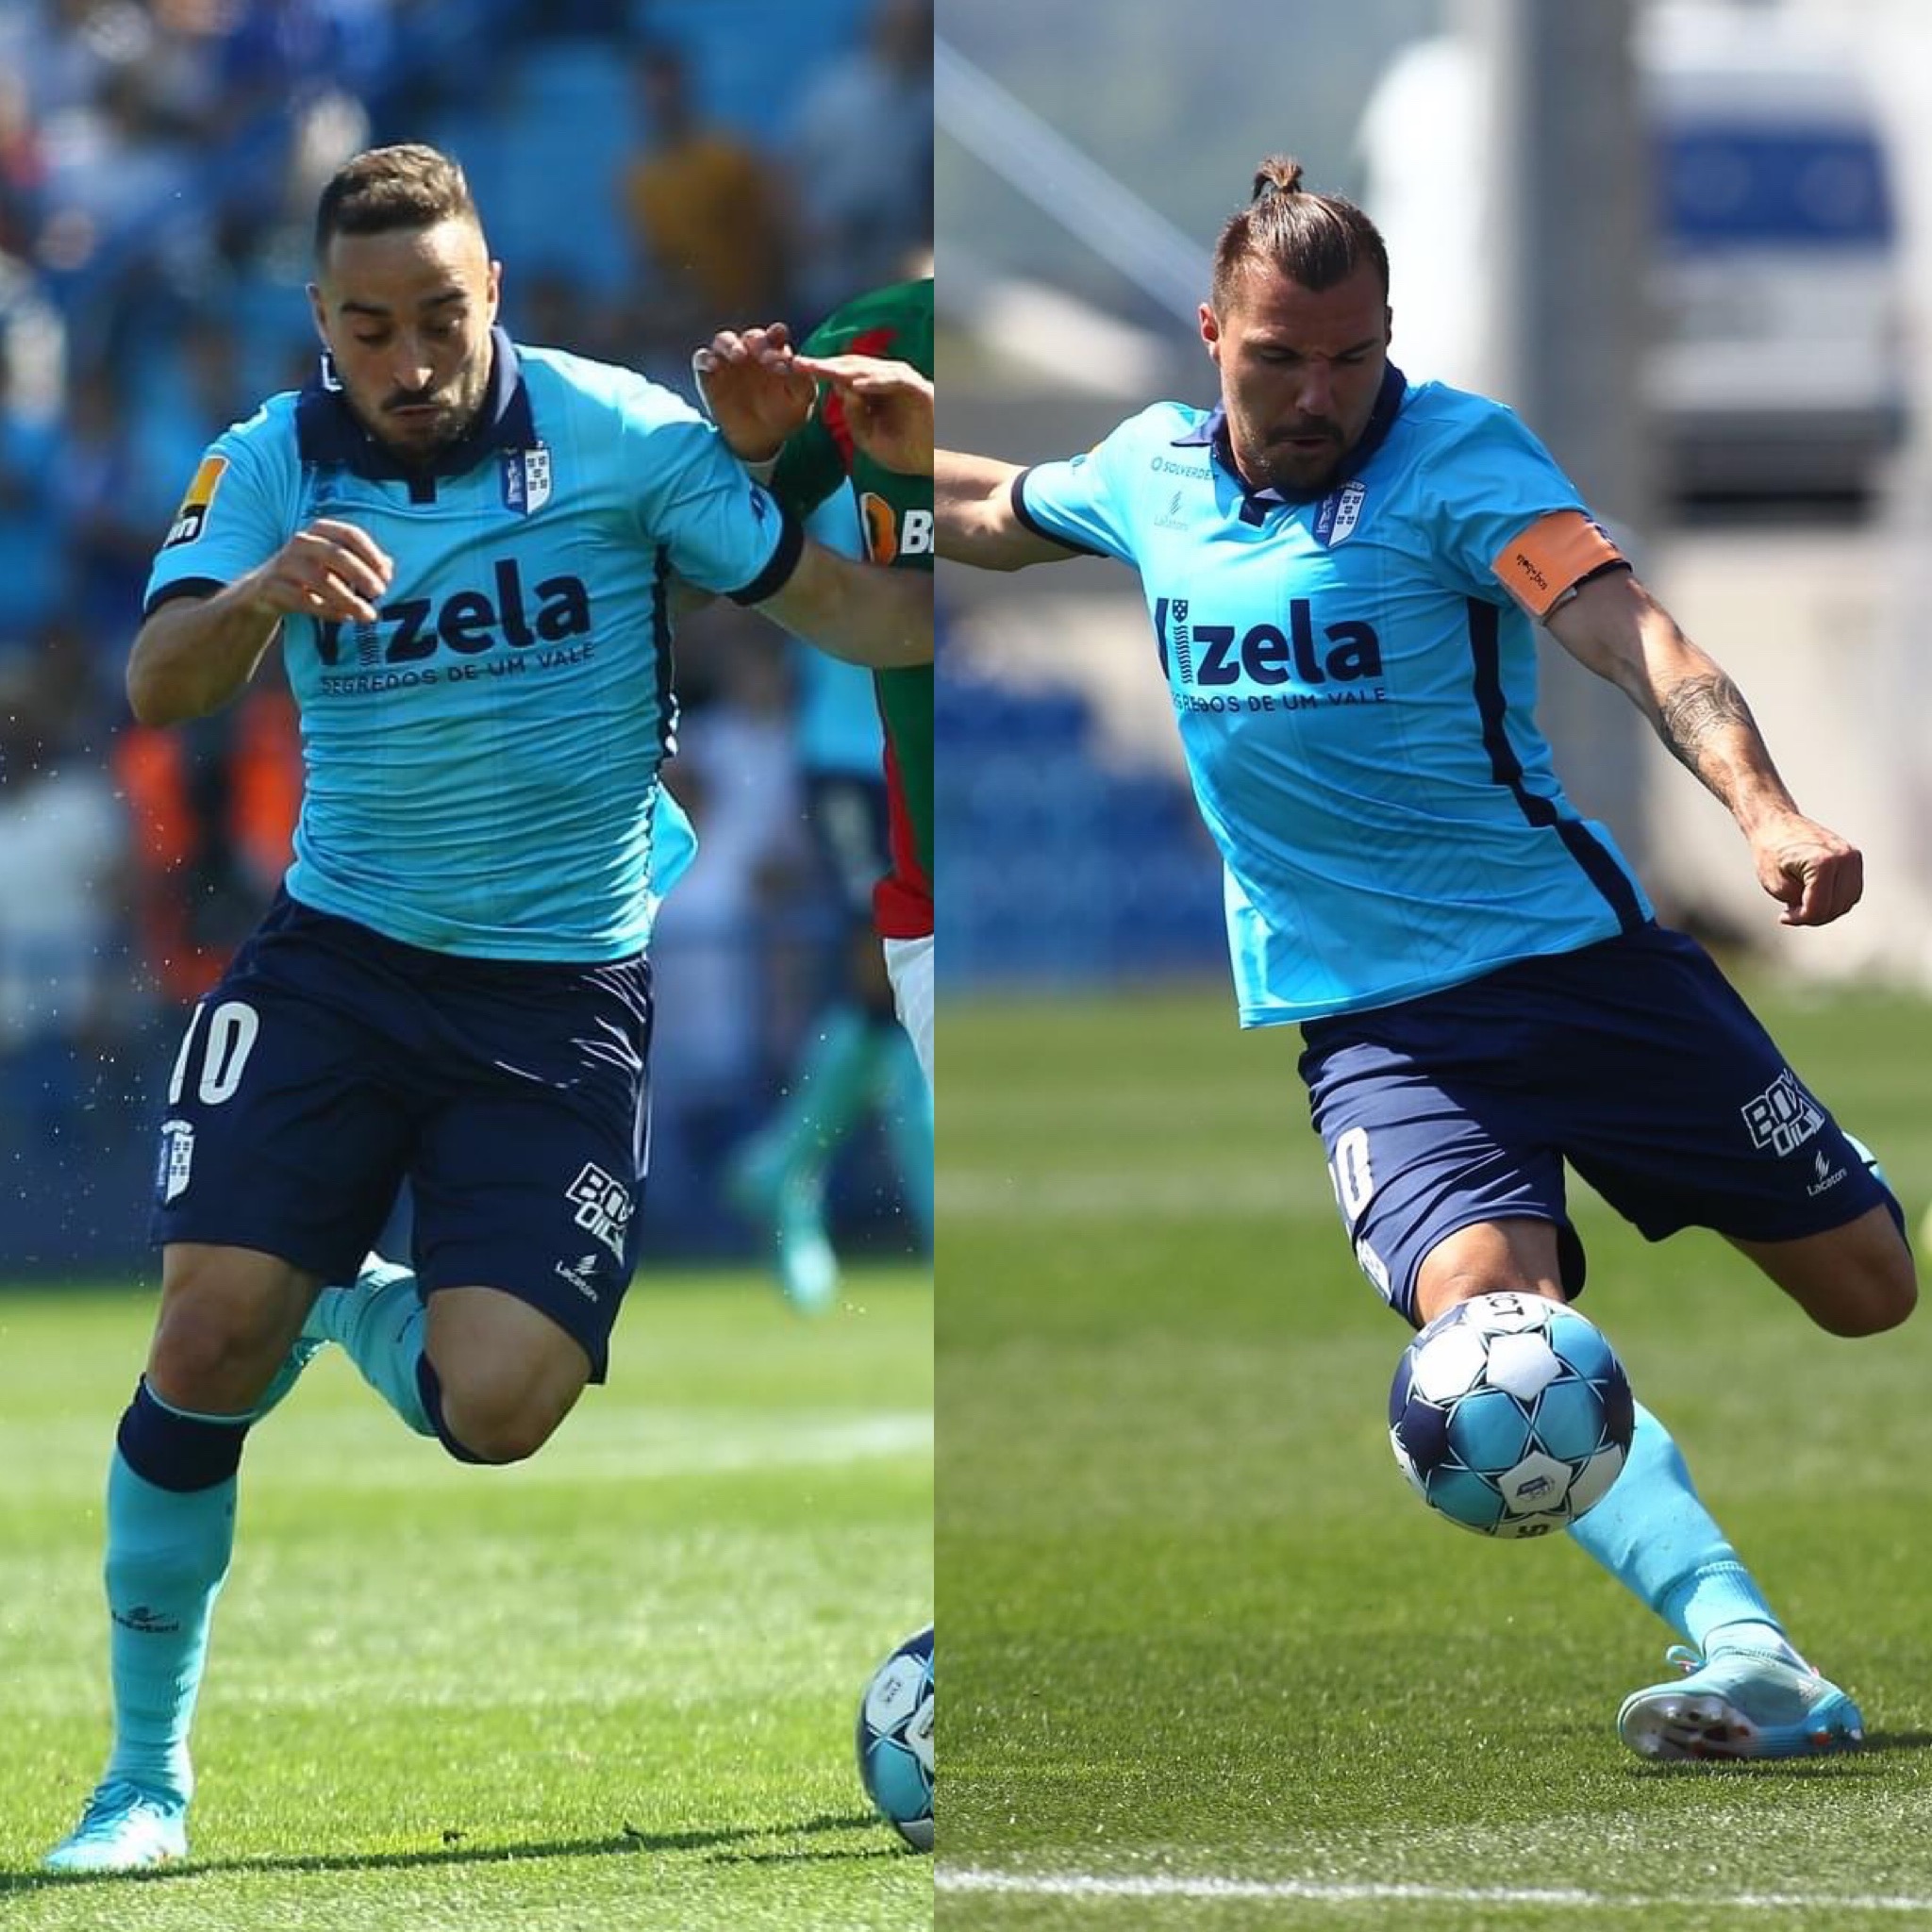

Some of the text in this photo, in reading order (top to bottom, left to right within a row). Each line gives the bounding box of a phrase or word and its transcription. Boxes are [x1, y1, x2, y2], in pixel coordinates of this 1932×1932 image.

[447, 663, 476, 683] DE
[488, 657, 526, 678] UM
[538, 641, 595, 671] VALE
[1247, 694, 1275, 713] DE
[1282, 692, 1319, 711] UM
[1327, 686, 1386, 707] VALE
[1327, 1125, 1374, 1222] 0
